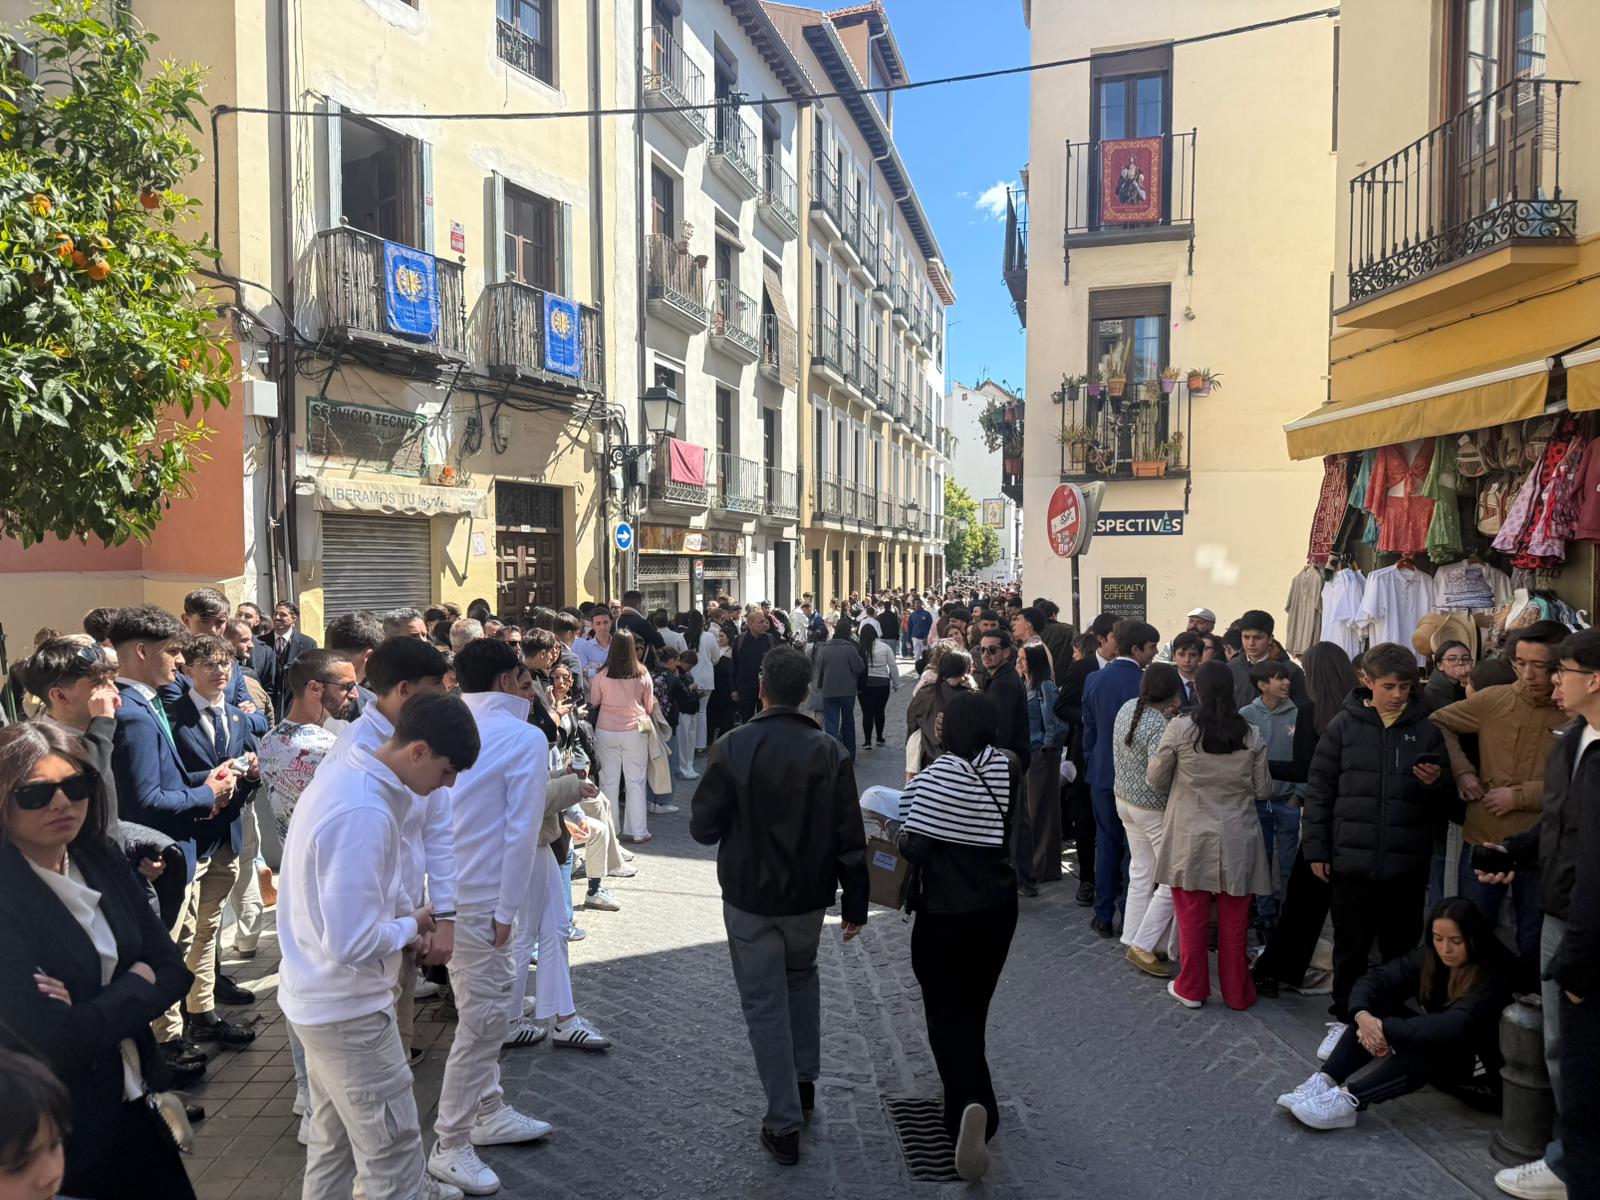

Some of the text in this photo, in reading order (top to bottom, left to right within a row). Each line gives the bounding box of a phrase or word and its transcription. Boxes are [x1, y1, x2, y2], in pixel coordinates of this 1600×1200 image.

[311, 403, 372, 424] SERVICIO
[325, 487, 396, 505] LIBERAMOS
[400, 492, 415, 505] TU
[1093, 512, 1182, 533] SPECTIVES
[1103, 583, 1145, 592] SPECIALTY
[1103, 592, 1135, 600] COFFEE
